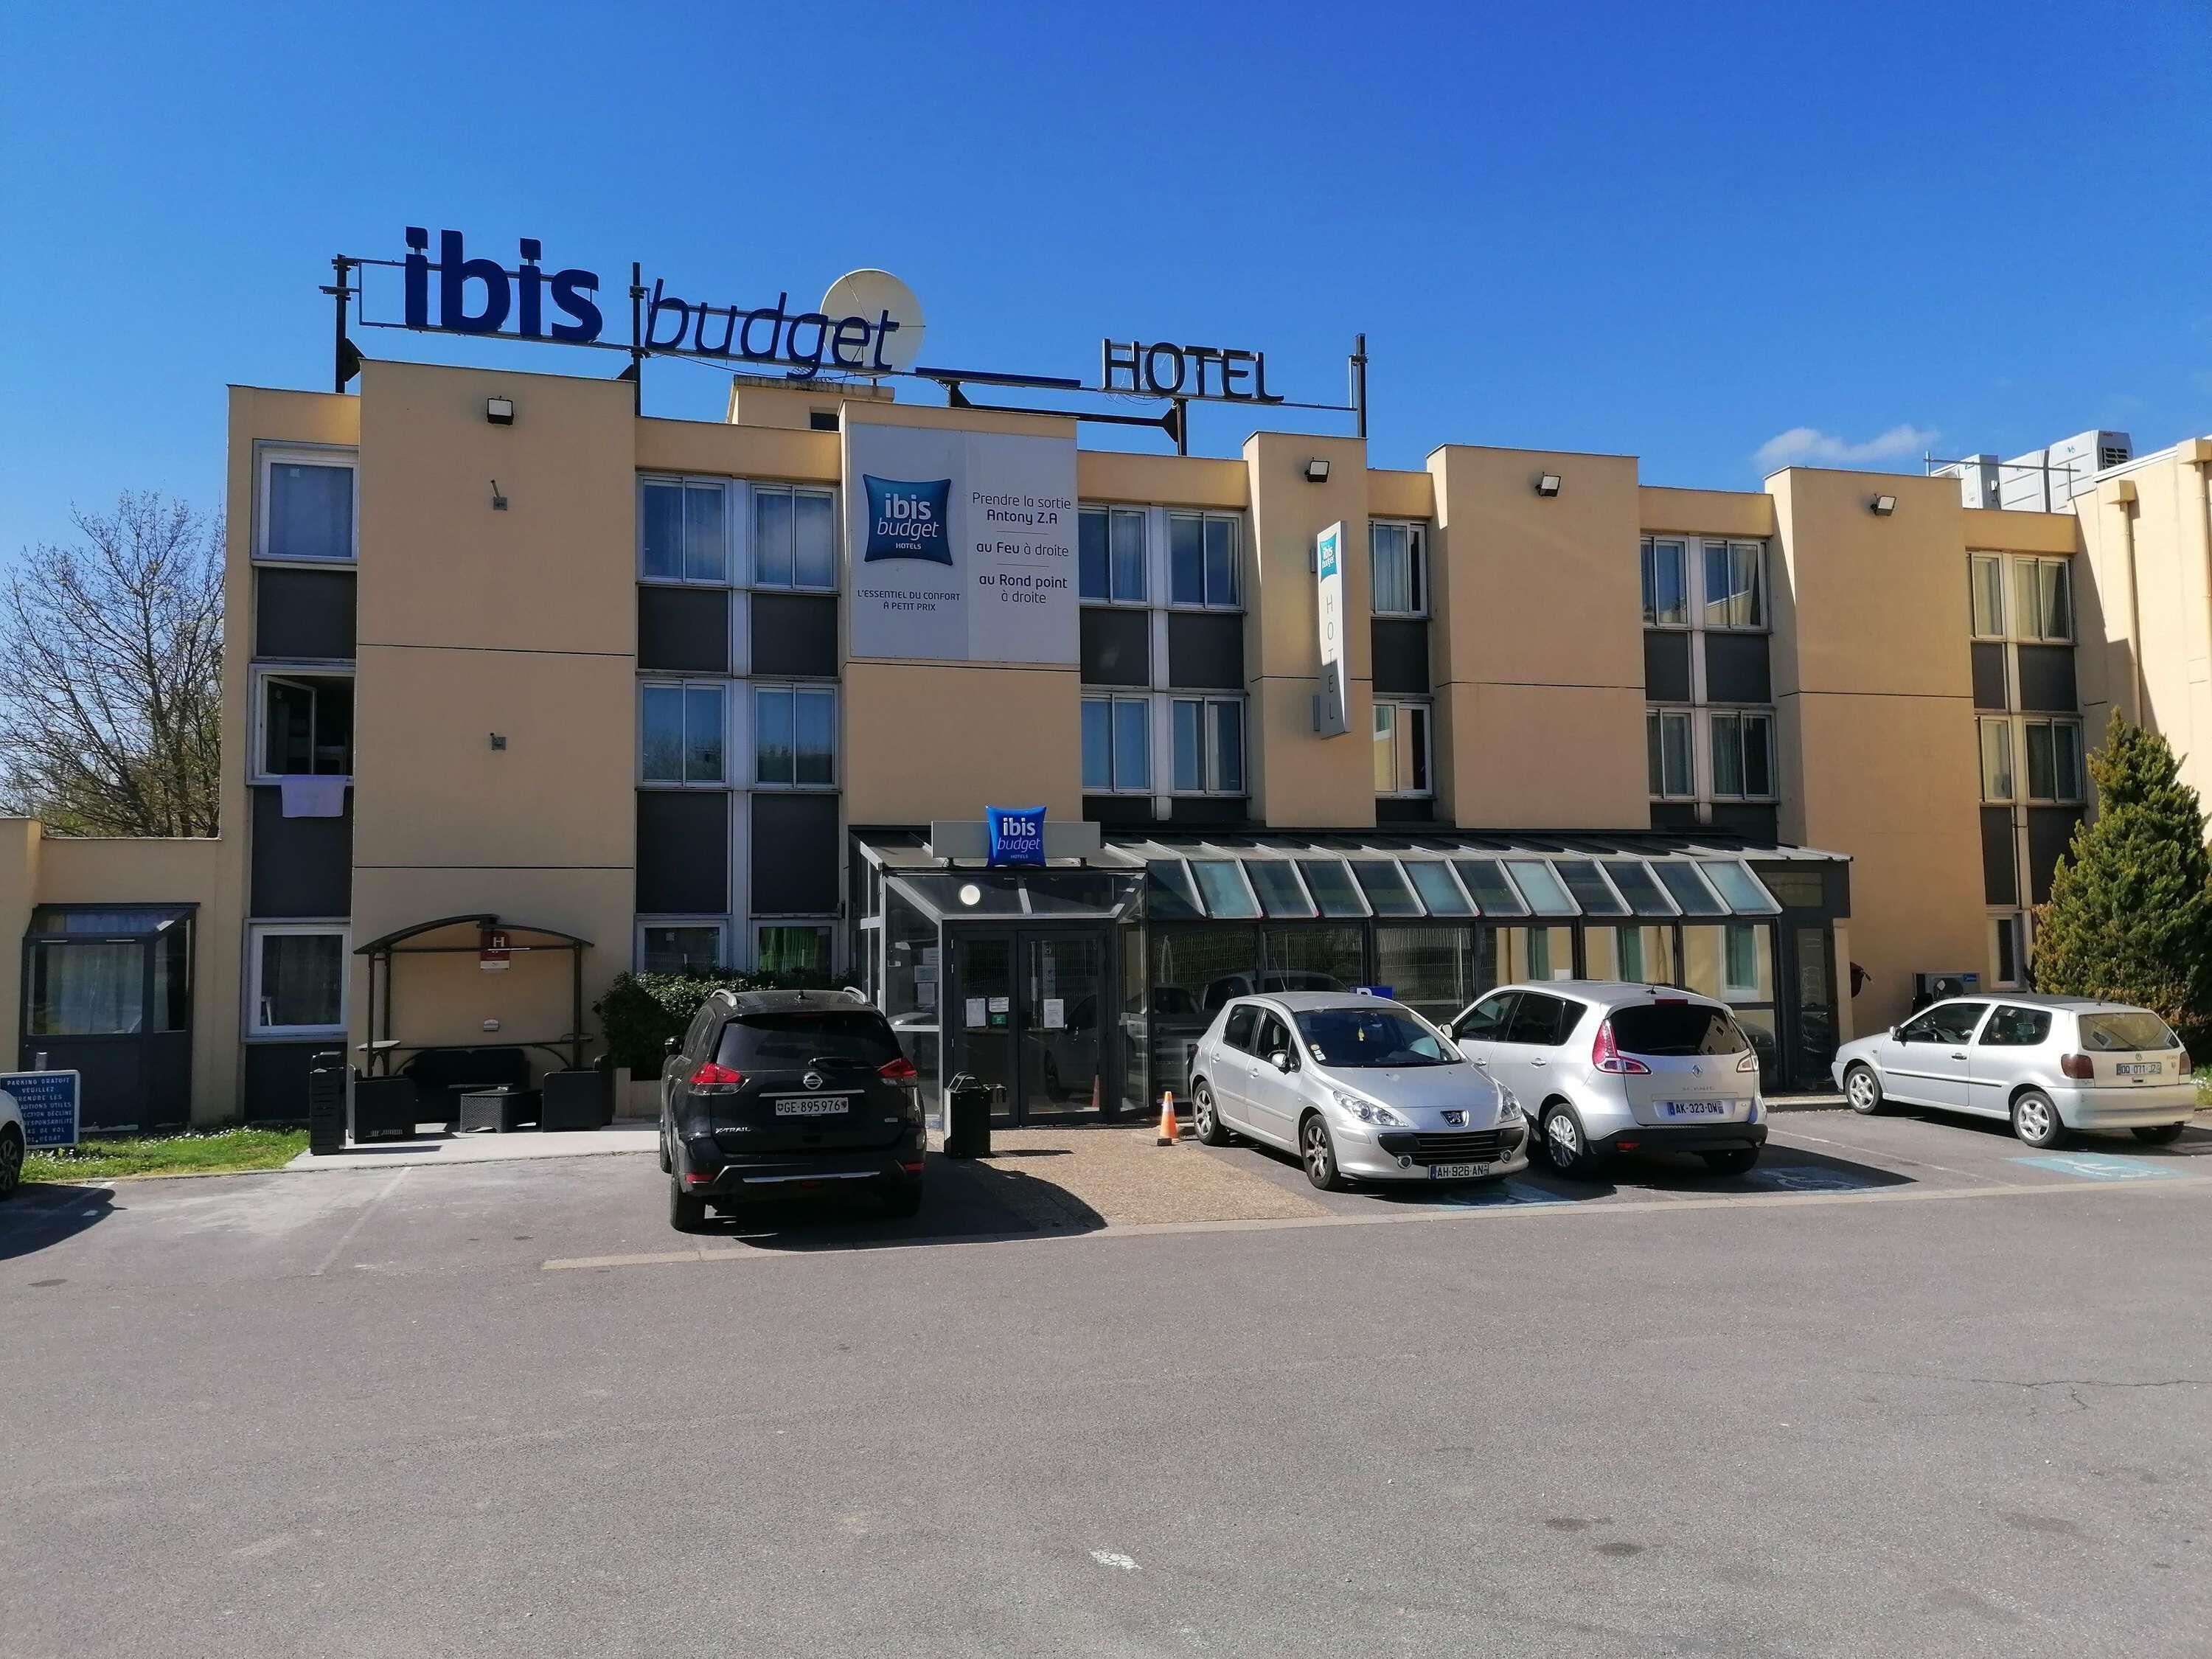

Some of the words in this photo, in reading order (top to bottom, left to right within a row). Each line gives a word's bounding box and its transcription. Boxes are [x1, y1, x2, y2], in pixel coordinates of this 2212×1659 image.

[404, 226, 603, 344] ibis
[645, 277, 900, 380] budget
[1102, 338, 1284, 402] HOTEL
[886, 493, 931, 520] ibis
[973, 492, 1020, 506] Prendre
[1024, 495, 1034, 507] la
[1038, 498, 1071, 509] sortie
[987, 509, 1032, 526] Antony
[1037, 512, 1057, 524] Z.A
[877, 518, 939, 541] budget
[976, 543, 992, 552] au
[997, 542, 1020, 554] Feu
[1023, 543, 1031, 554] à
[1035, 543, 1069, 557] droite
[979, 575, 995, 585] au
[1000, 574, 1032, 586] Rond
[1036, 577, 1068, 590] point
[909, 591, 921, 599] DU
[923, 592, 961, 600] CONFORT
[1001, 590, 1008, 602] à
[1012, 591, 1046, 604] droite
[883, 600, 889, 610] À
[891, 602, 915, 611] PETIT
[917, 603, 936, 611] PRIX
[1003, 817, 1036, 836] ibis
[998, 837, 1041, 853] budget
